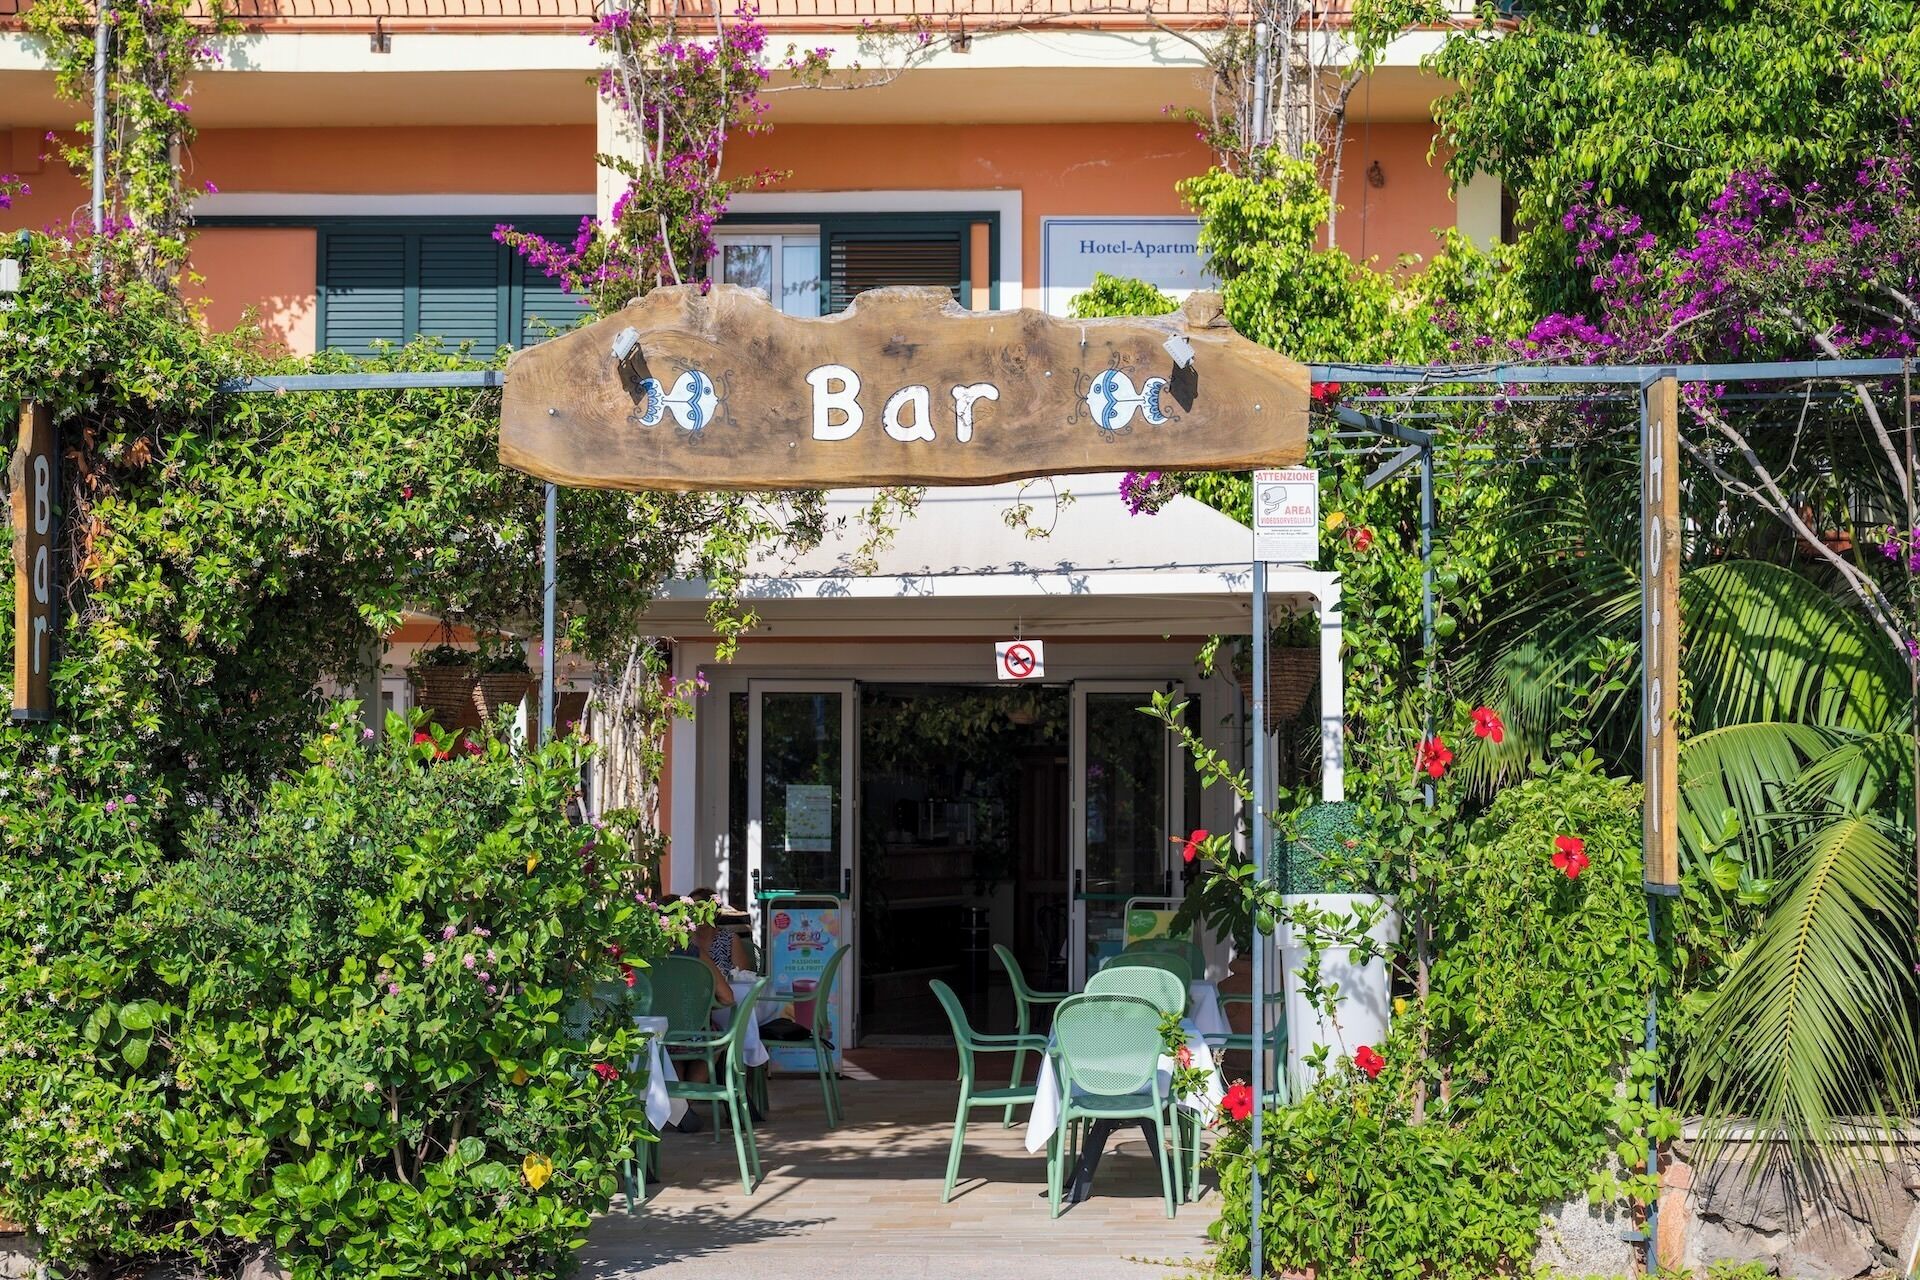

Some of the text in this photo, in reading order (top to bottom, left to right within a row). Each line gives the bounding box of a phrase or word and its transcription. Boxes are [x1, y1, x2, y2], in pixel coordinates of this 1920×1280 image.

[1079, 240, 1214, 258] Hotel-Apartmn
[805, 364, 999, 443] Bar
[1257, 472, 1315, 481] ATTENZIONE
[1285, 505, 1312, 515] AREA
[33, 454, 50, 674] Bar
[1648, 420, 1662, 833] Hotel
